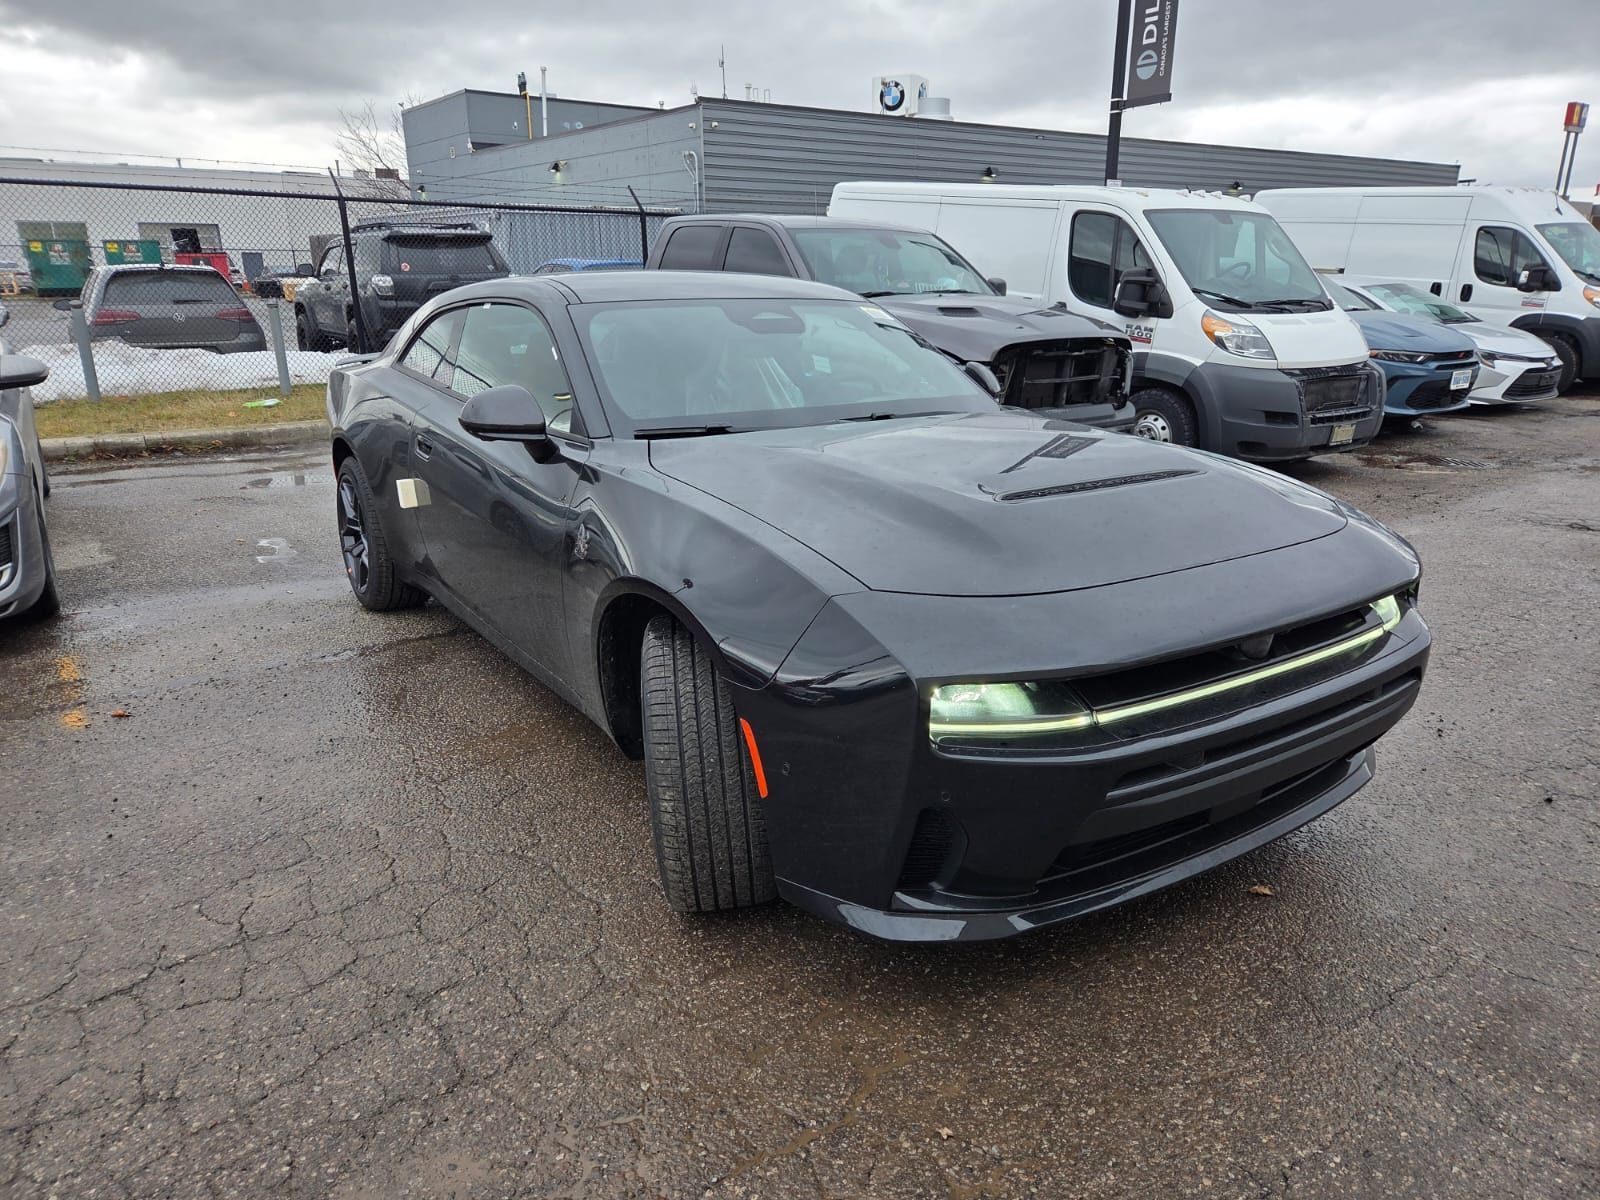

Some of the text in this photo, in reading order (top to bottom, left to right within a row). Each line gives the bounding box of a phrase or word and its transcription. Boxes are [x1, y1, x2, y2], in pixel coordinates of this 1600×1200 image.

[1159, 0, 1171, 76] CANADA'S LARGEST
[1126, 324, 1153, 332] RAM
